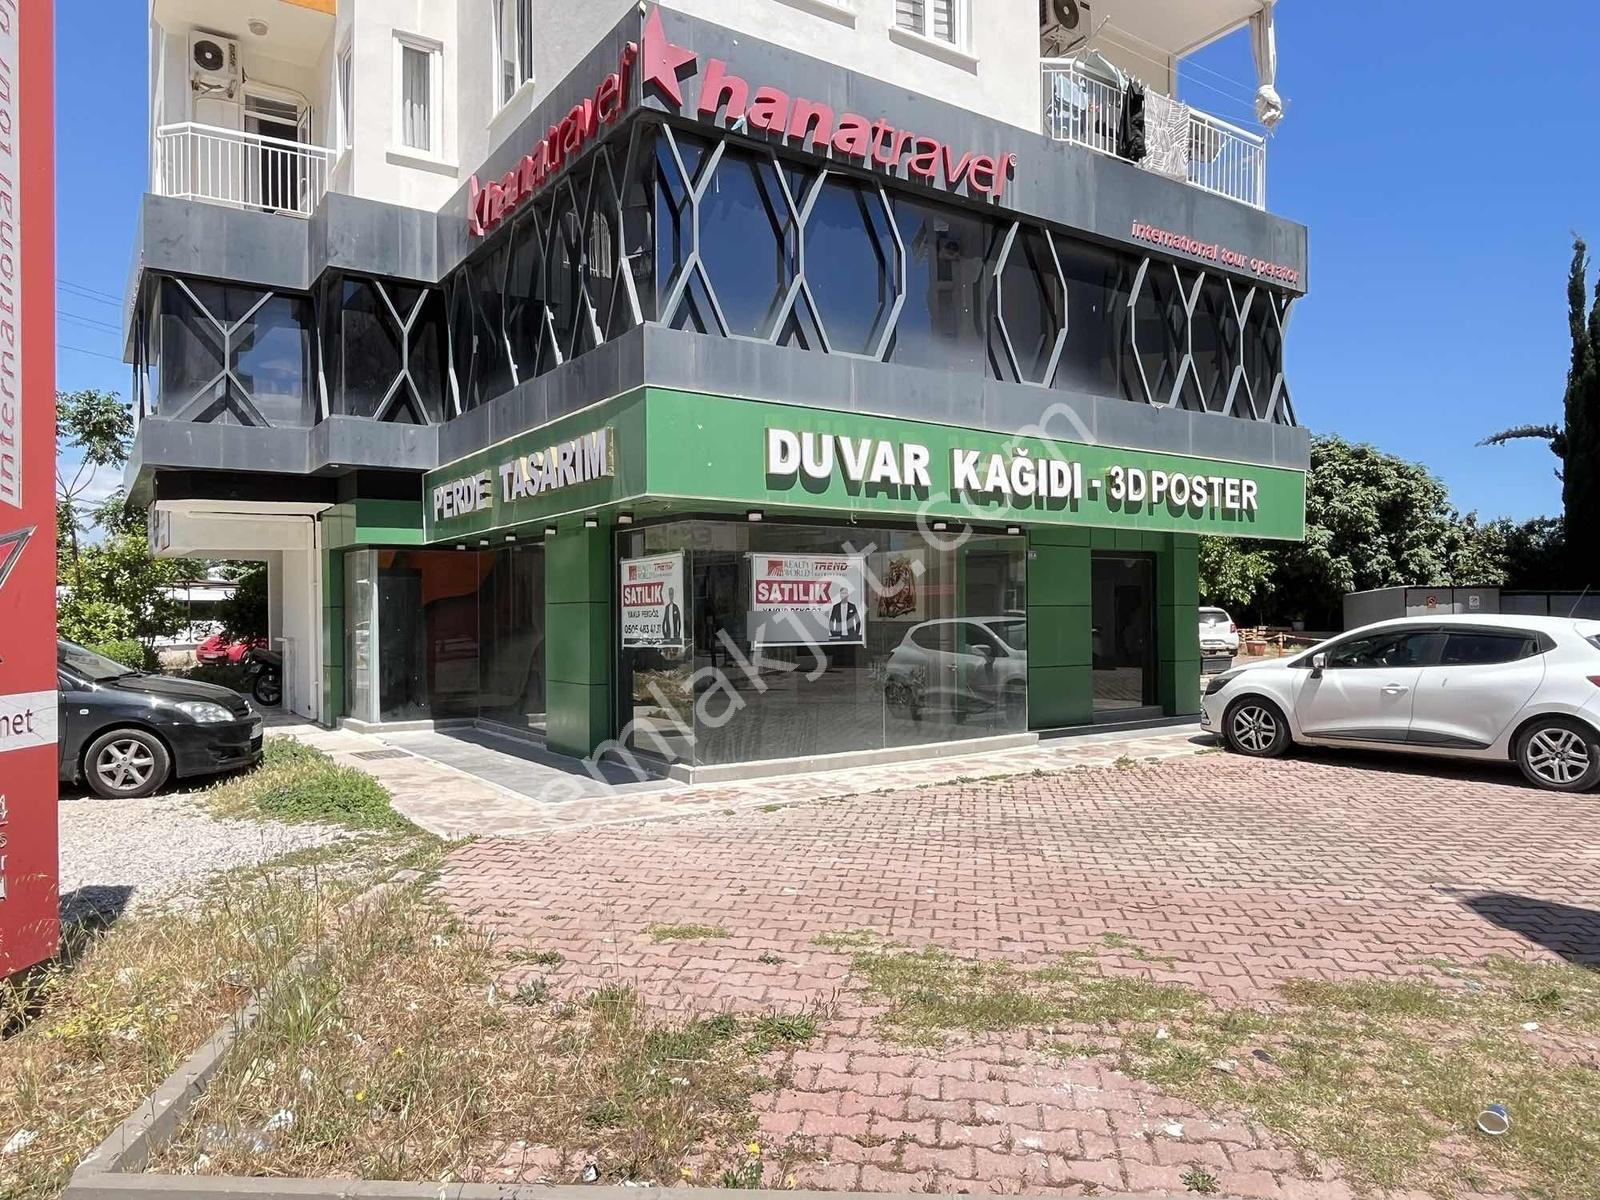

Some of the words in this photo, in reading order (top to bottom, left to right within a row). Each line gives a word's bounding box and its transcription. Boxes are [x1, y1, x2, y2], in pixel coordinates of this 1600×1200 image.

[1132, 219, 1219, 261] international
[1221, 247, 1248, 270] tour
[1250, 257, 1300, 286] operator
[433, 470, 493, 522] PERDE
[499, 426, 615, 503] TASARIM
[766, 427, 932, 487] DUVAR
[952, 447, 1082, 499] KAĞIDI
[1109, 465, 1147, 502] 3D
[1151, 470, 1258, 510] POSTER
[814, 561, 848, 571] TREND
[624, 585, 662, 605] SATILIK
[758, 583, 828, 601] SATILIK
